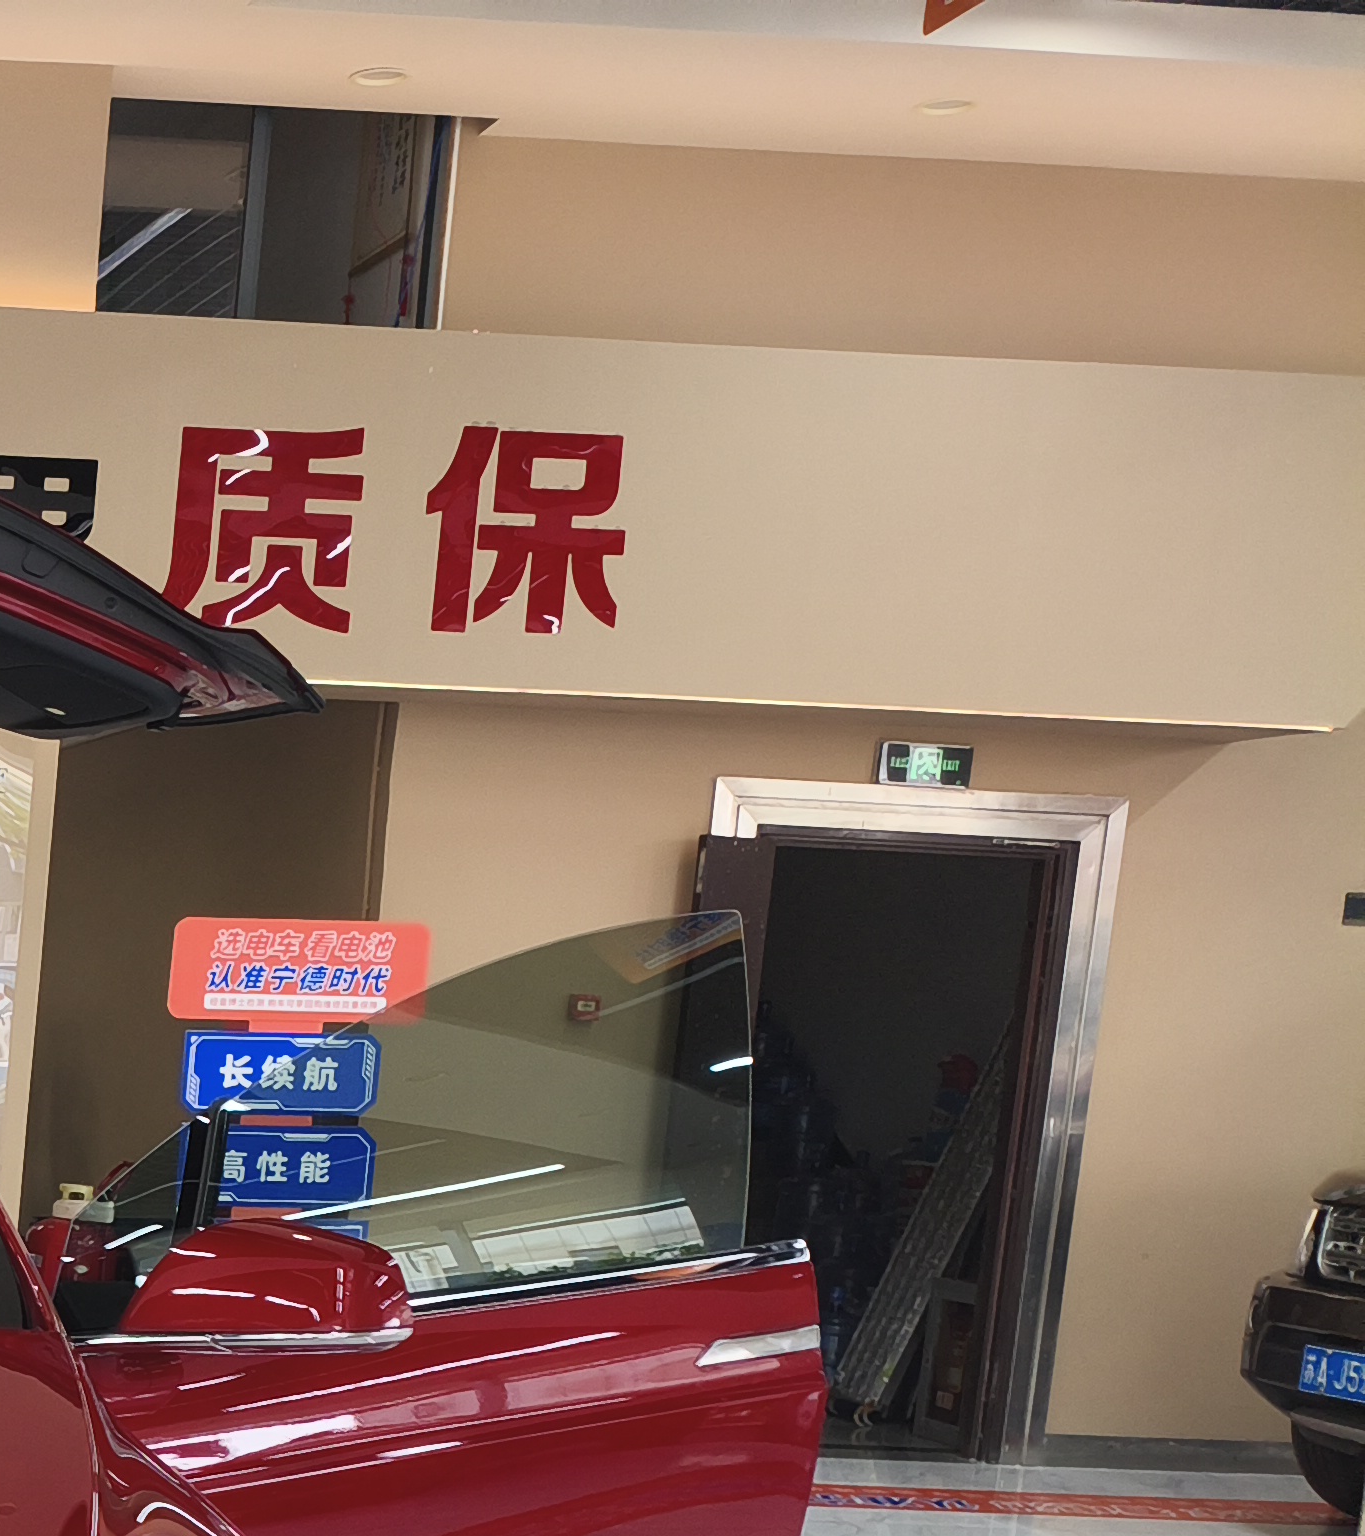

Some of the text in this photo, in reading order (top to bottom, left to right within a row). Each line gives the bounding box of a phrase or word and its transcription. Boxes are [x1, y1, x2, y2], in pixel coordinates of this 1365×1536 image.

[206, 962, 392, 995] 认准宁德时代
[218, 1052, 340, 1092] 长续航
[223, 1149, 332, 1184] 高性能
